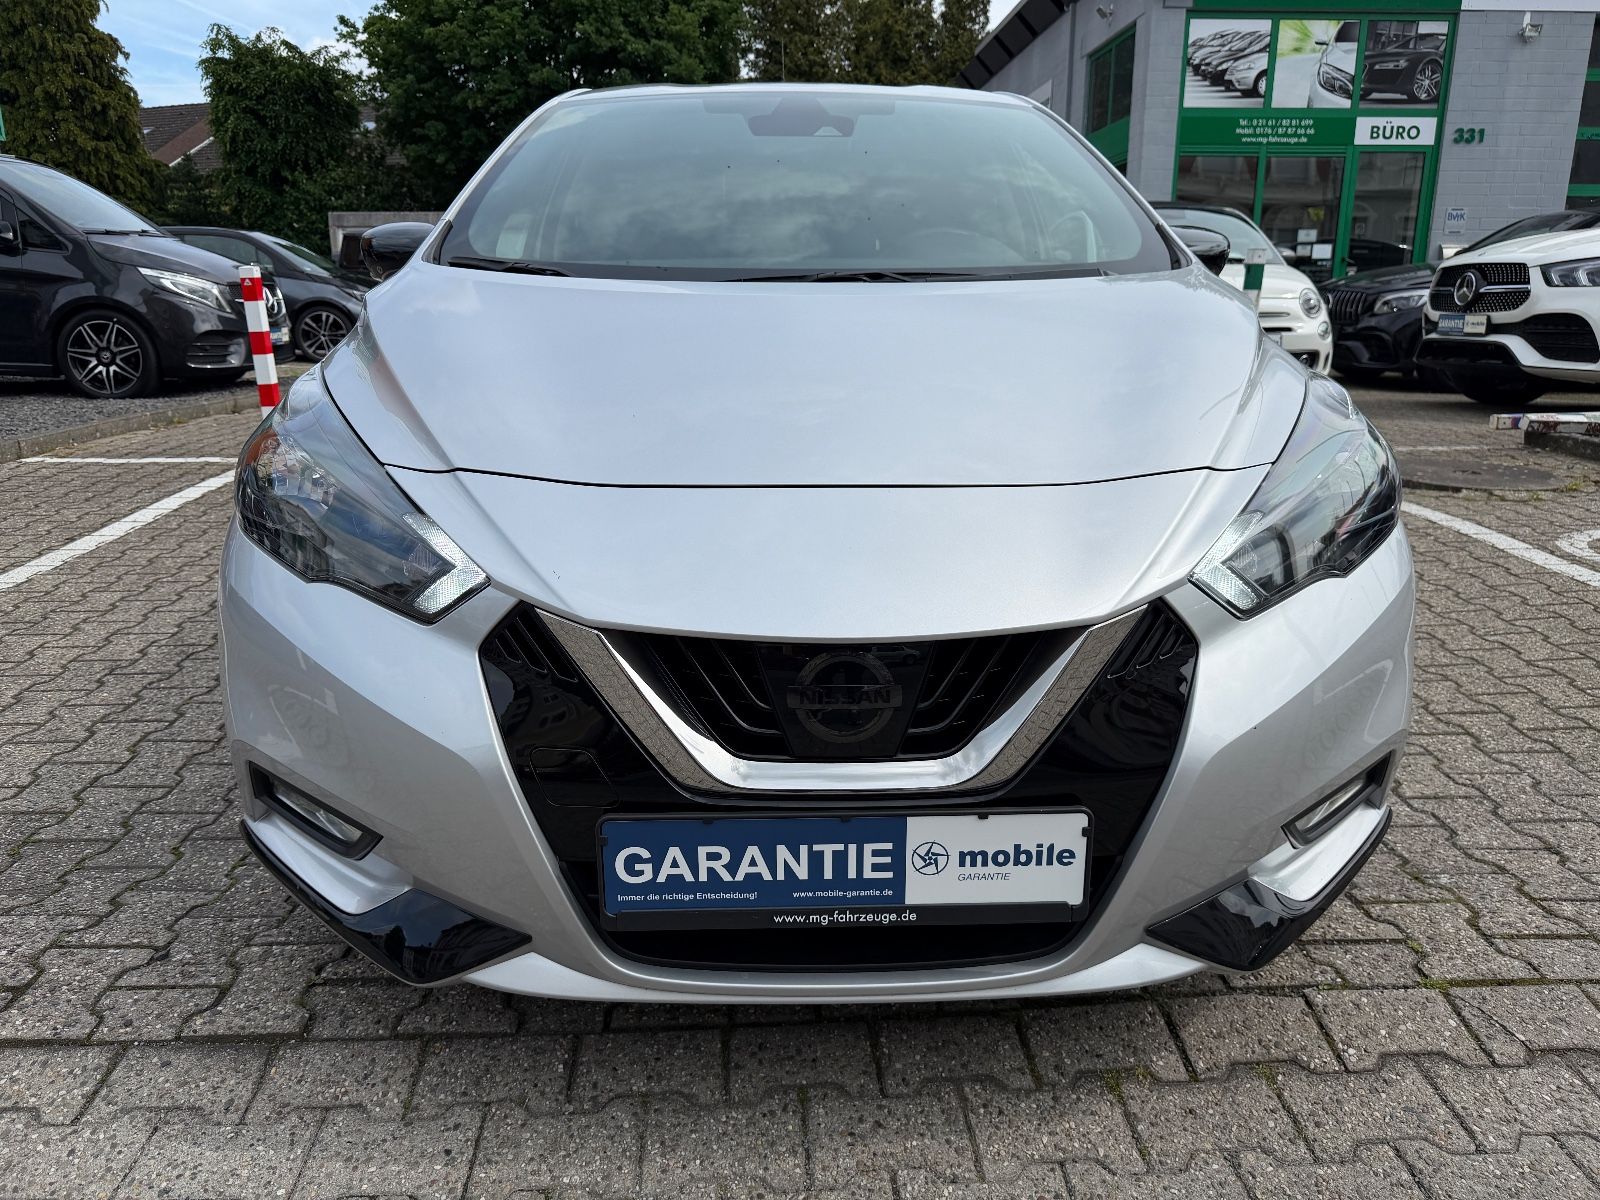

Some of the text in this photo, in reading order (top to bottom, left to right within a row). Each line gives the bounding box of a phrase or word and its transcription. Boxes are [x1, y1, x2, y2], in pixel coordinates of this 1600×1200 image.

[1369, 121, 1421, 140] BÜRO
[1453, 128, 1485, 144] 331
[799, 688, 892, 705] NISSAN
[614, 842, 894, 884] GARANTIE
[958, 843, 1077, 868] mobile
[957, 872, 1011, 881] GARANTIE
[617, 891, 758, 902] Immer die richtige Entscheidung!
[792, 888, 894, 898] www.mobile-garantie.de
[773, 910, 917, 926] www.mg-fahrzeuge.de
